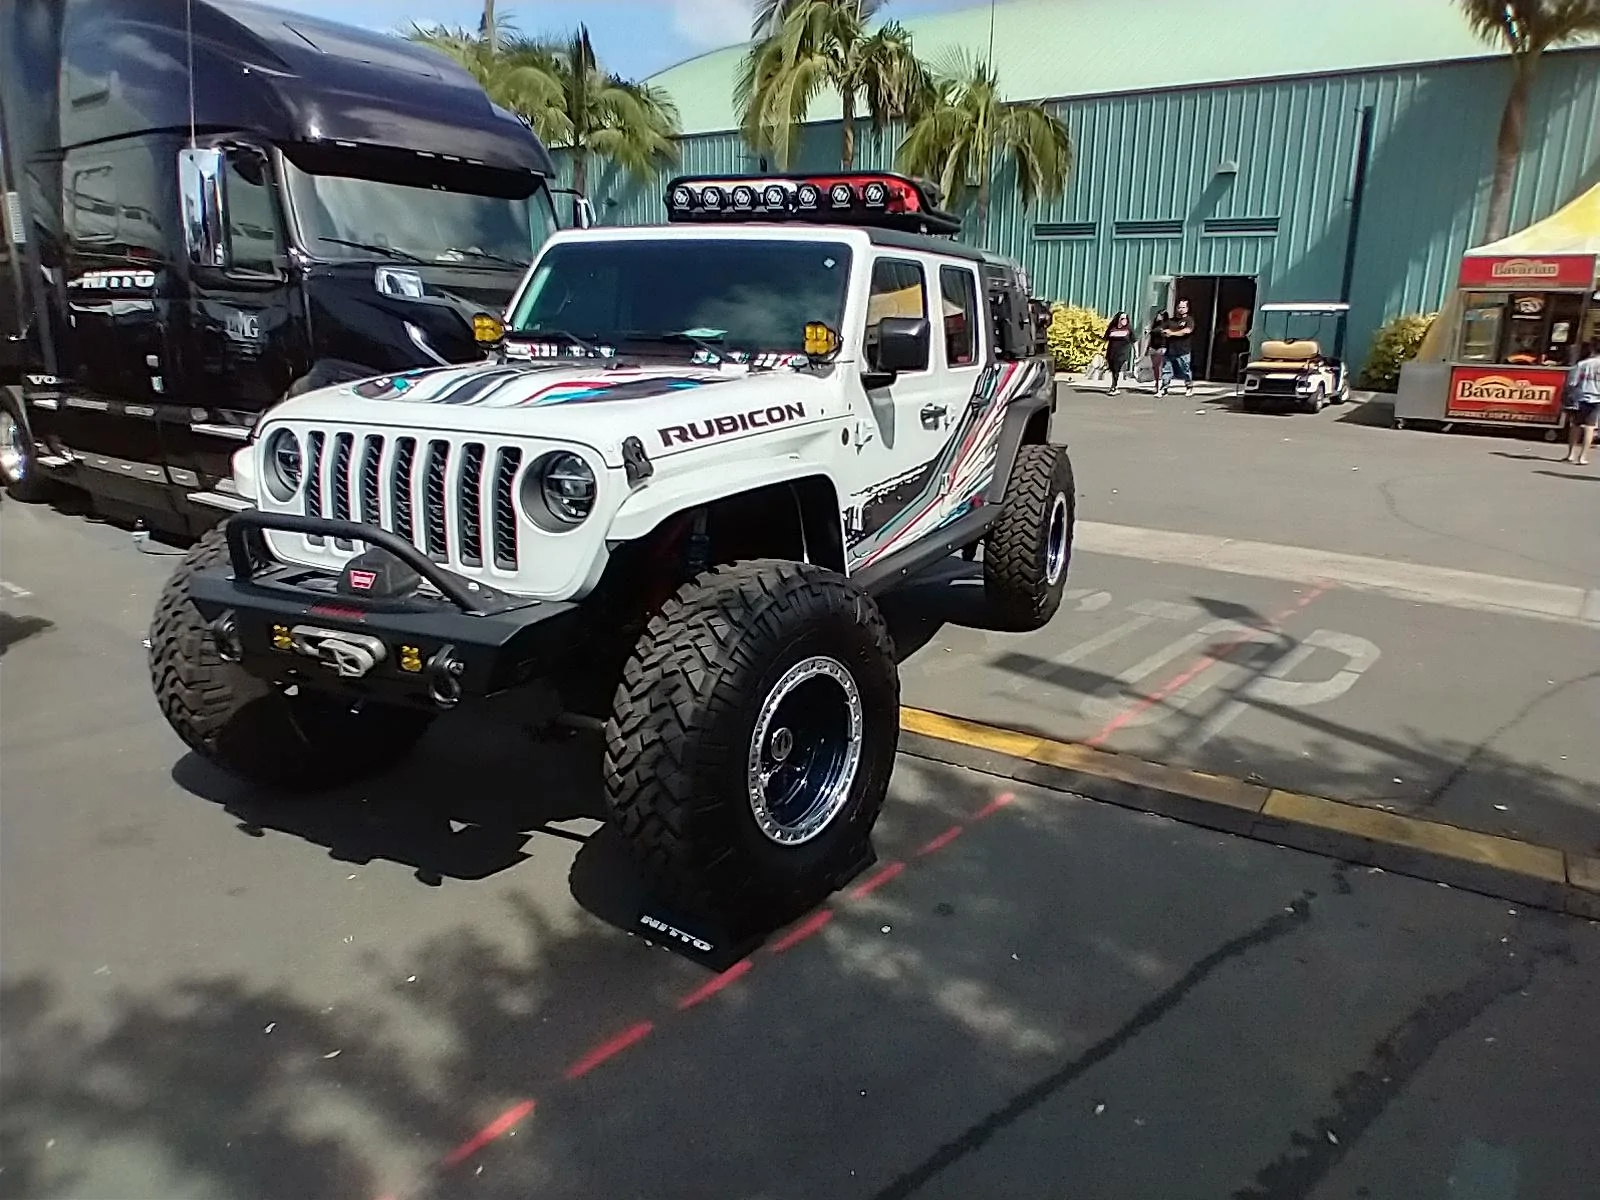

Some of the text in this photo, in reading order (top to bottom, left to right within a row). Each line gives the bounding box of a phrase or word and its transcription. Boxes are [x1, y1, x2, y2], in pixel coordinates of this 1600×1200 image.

[1494, 263, 1556, 275] Bavarian
[1460, 381, 1551, 401] Bavarian
[658, 402, 806, 447] RUBICON
